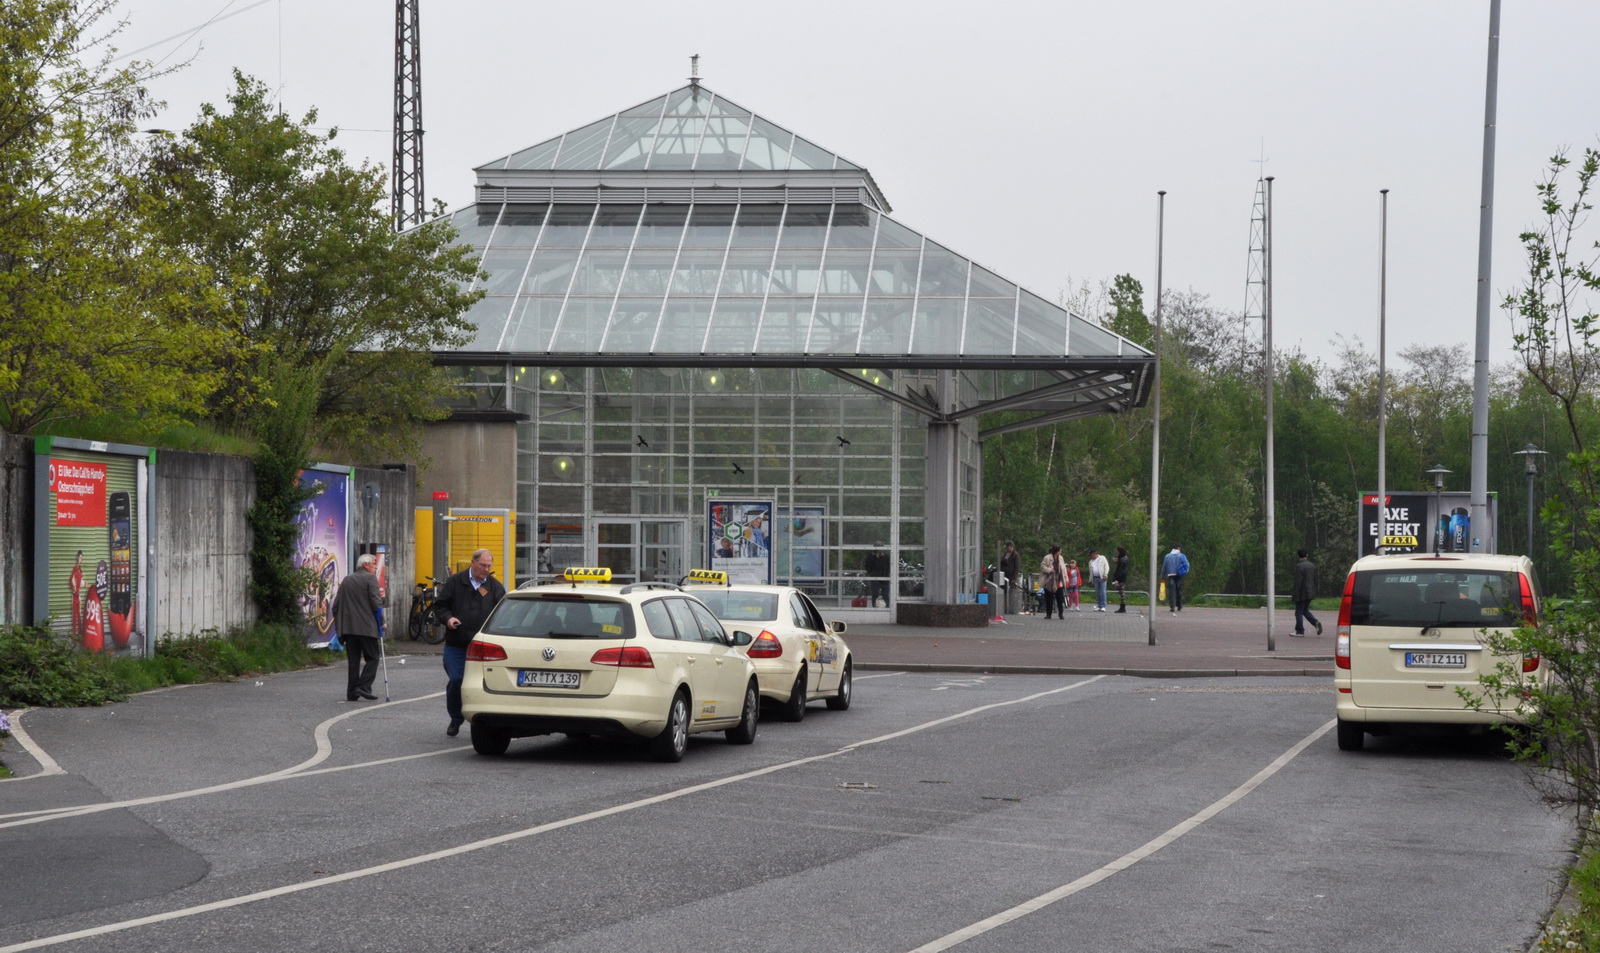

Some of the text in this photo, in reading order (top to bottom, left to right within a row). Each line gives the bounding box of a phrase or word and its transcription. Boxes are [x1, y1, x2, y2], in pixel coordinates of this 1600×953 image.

[1370, 522, 1420, 536] EFEKT
[571, 568, 601, 576] TAXI
[693, 570, 719, 579] TAXI
[86, 599, 101, 625] 99€
[1412, 654, 1464, 665] KR IZ 111
[524, 672, 578, 684] KR TX 139
